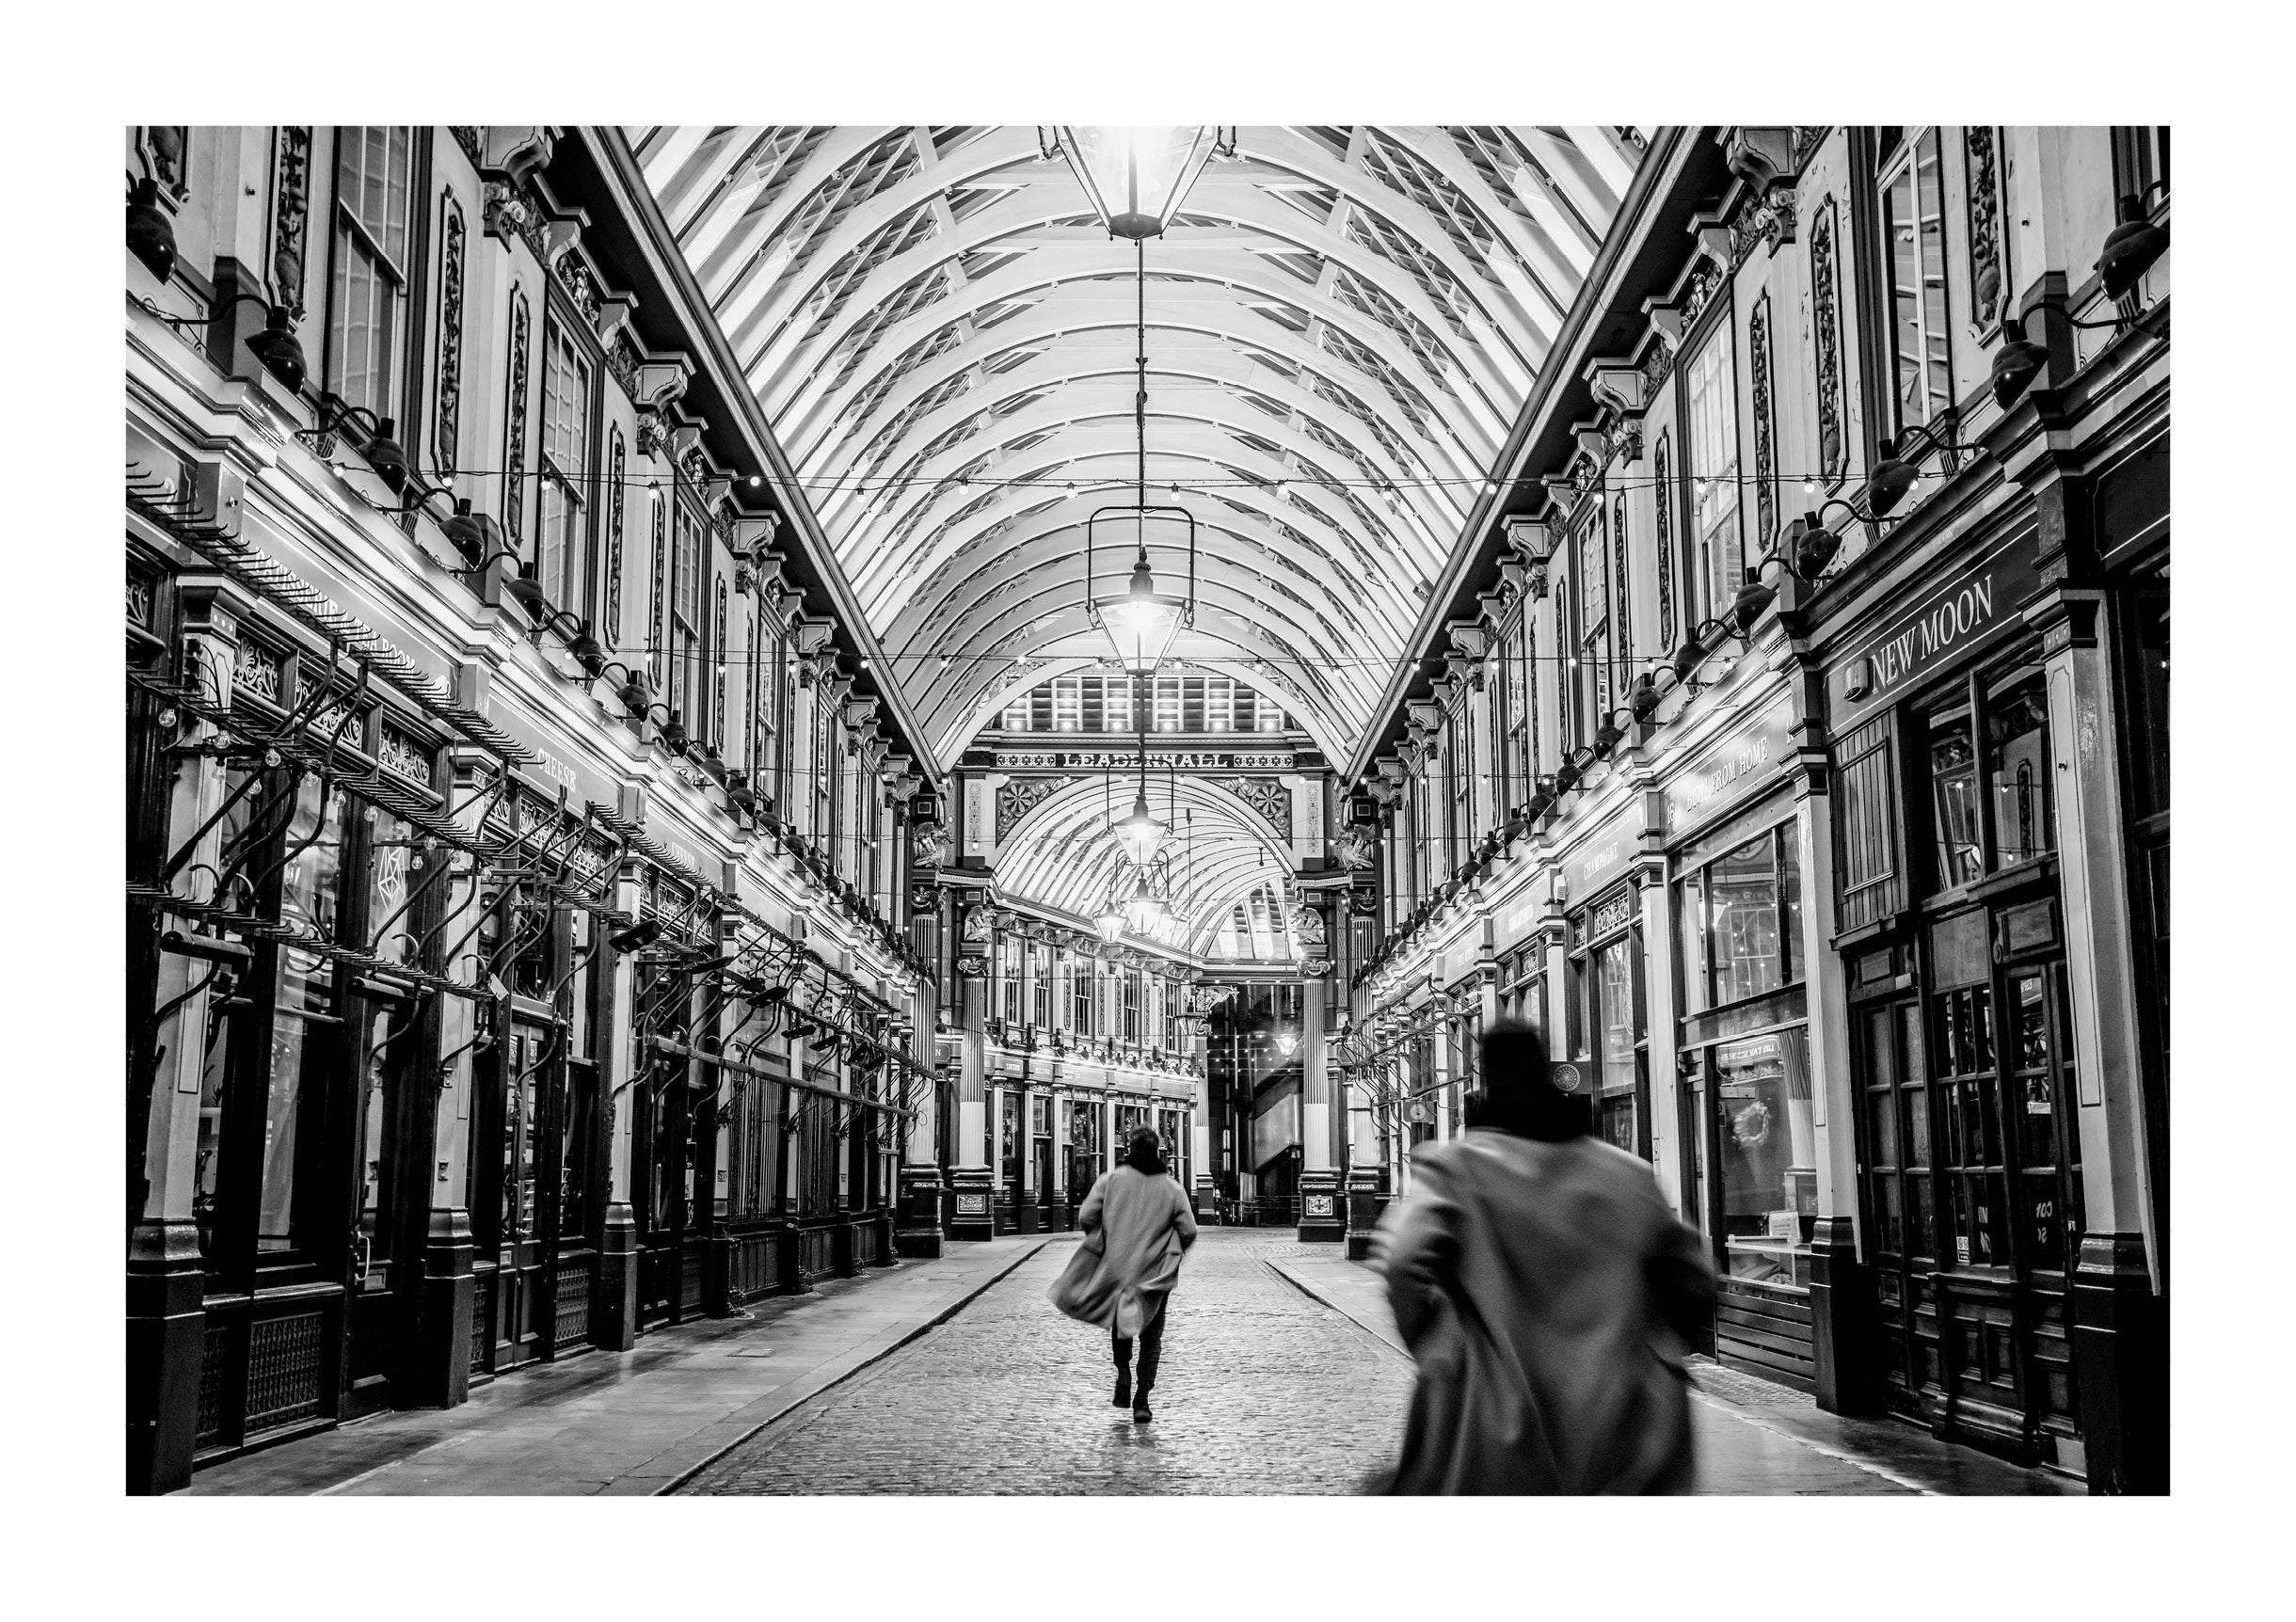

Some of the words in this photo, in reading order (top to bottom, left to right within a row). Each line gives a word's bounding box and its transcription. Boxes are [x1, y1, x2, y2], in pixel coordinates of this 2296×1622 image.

[1871, 626, 1917, 695] NEW
[1920, 573, 1992, 660] MOON
[537, 748, 577, 793] CHEESE
[1063, 754, 1228, 769] LEADENHALL
[1666, 802, 1675, 825] 16
[1711, 759, 1737, 794] FROM
[1740, 736, 1768, 776] HOME
[1583, 841, 1618, 881] CHAMPAGNE
